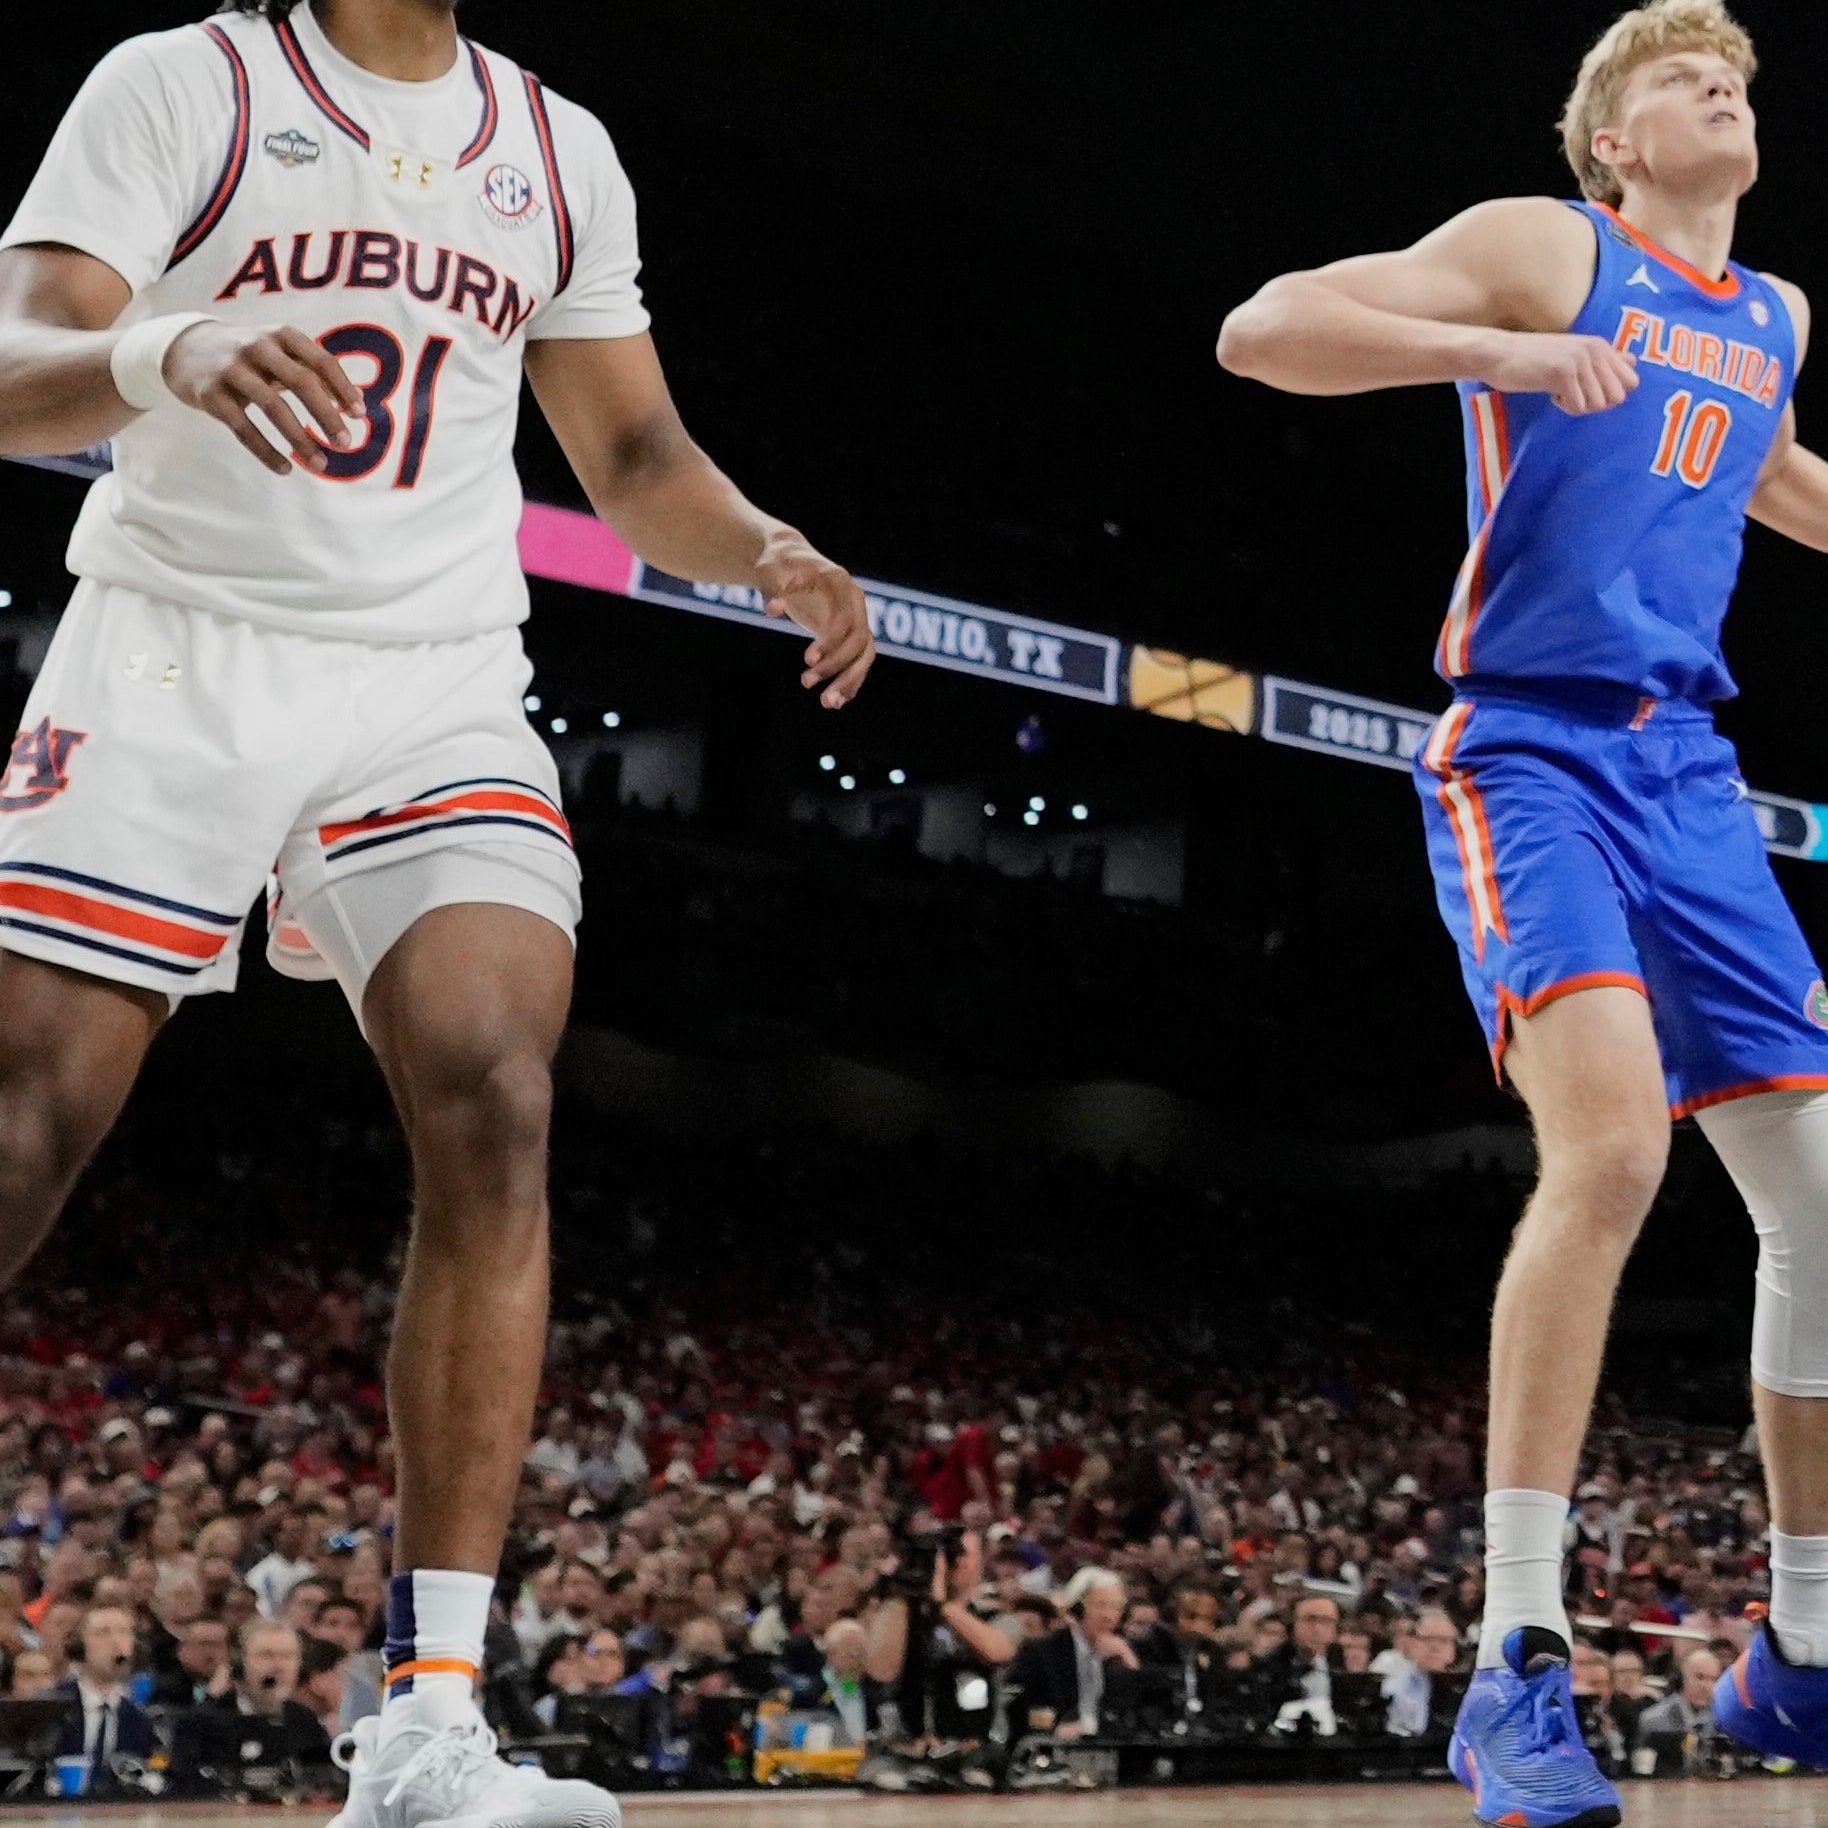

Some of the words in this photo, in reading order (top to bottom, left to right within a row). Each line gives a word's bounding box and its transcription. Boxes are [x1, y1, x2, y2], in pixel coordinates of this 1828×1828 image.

[486, 165, 530, 214] SEC
[215, 230, 539, 345] AUBURN
[290, 322, 453, 489] 31
[1611, 306, 1783, 410] FLORIDA
[1650, 389, 1732, 490] 10
[867, 596, 997, 666] TONIO,
[1006, 629, 1065, 680] TX
